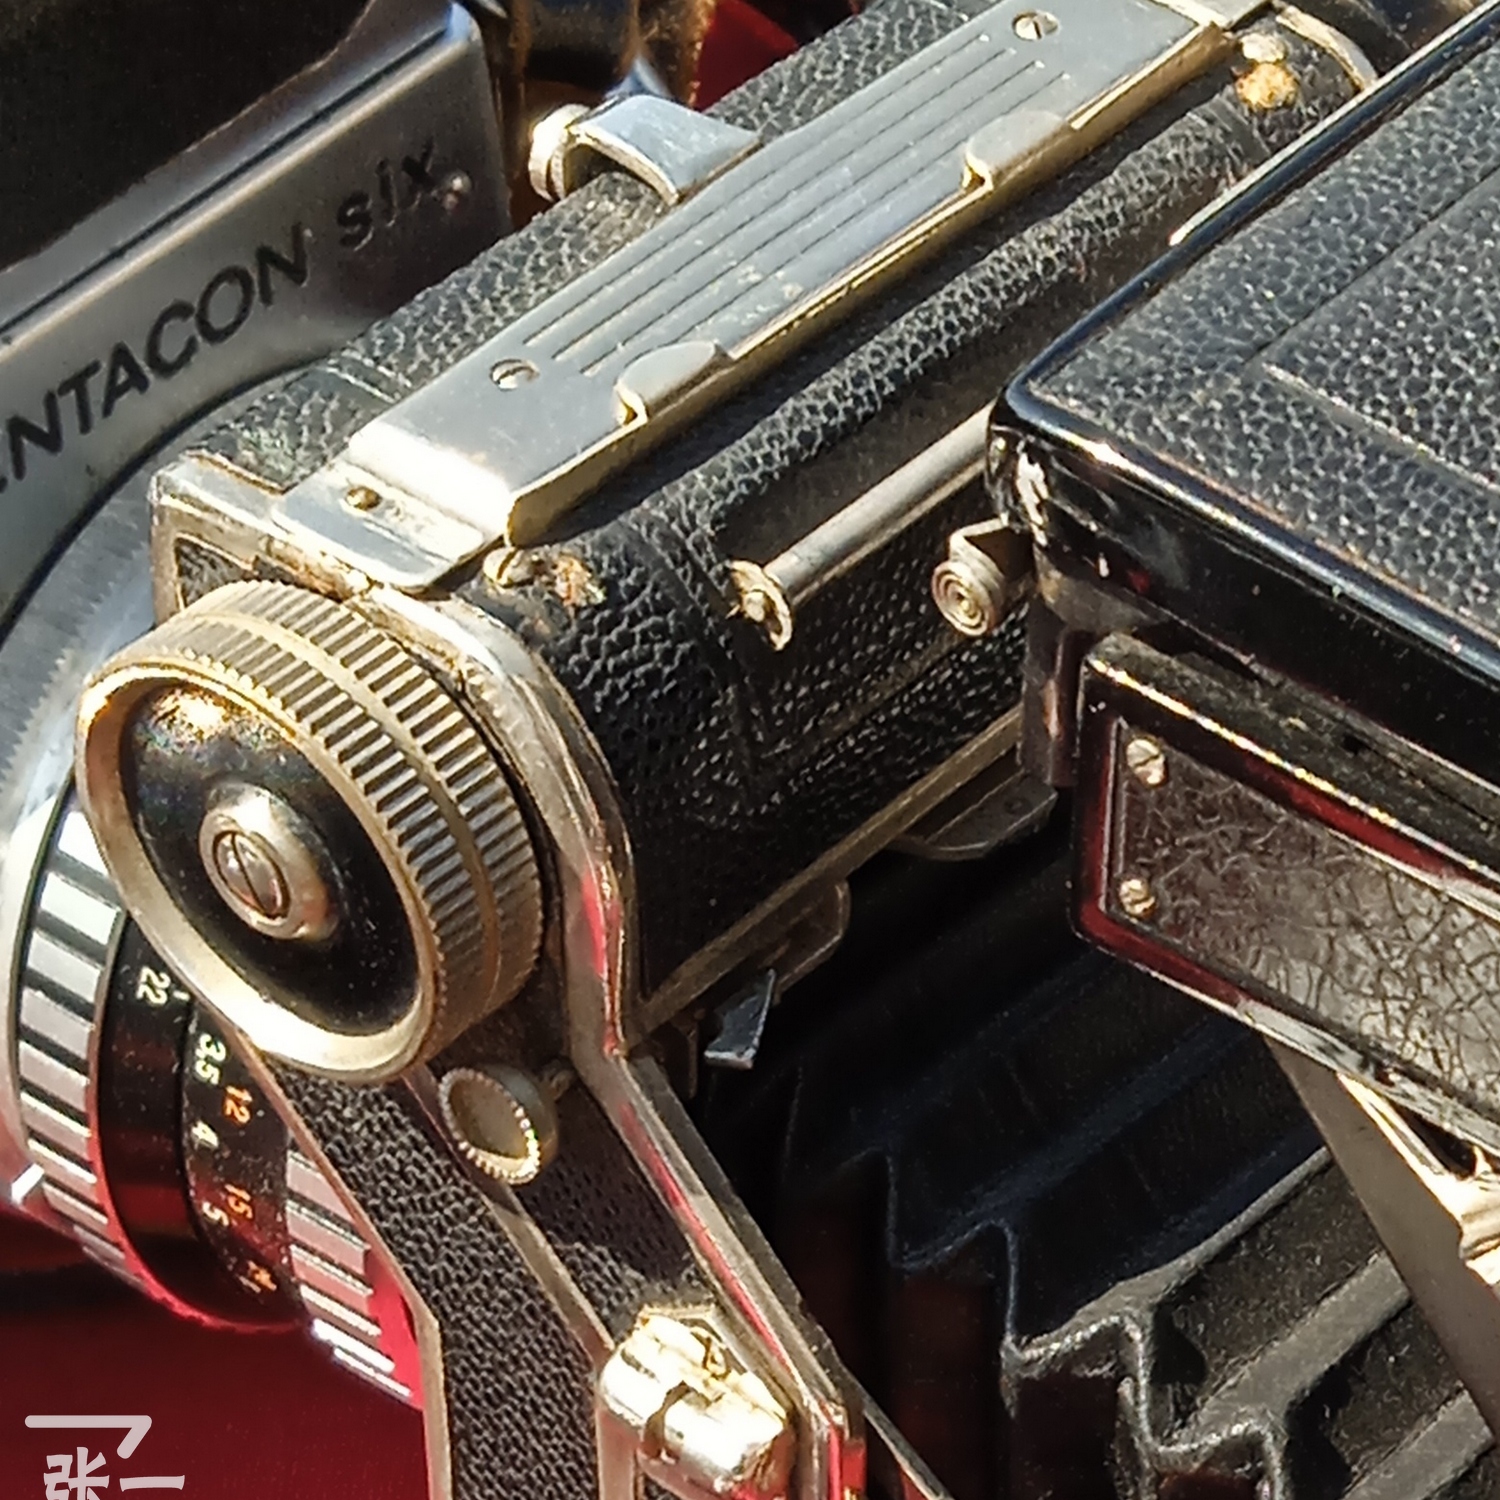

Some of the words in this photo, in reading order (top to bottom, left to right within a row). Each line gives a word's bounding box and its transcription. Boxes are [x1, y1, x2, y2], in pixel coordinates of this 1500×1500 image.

[0, 222, 310, 495] NTACON
[336, 137, 440, 250] six
[136, 965, 171, 1006] 22
[202, 1201, 229, 1226] 5
